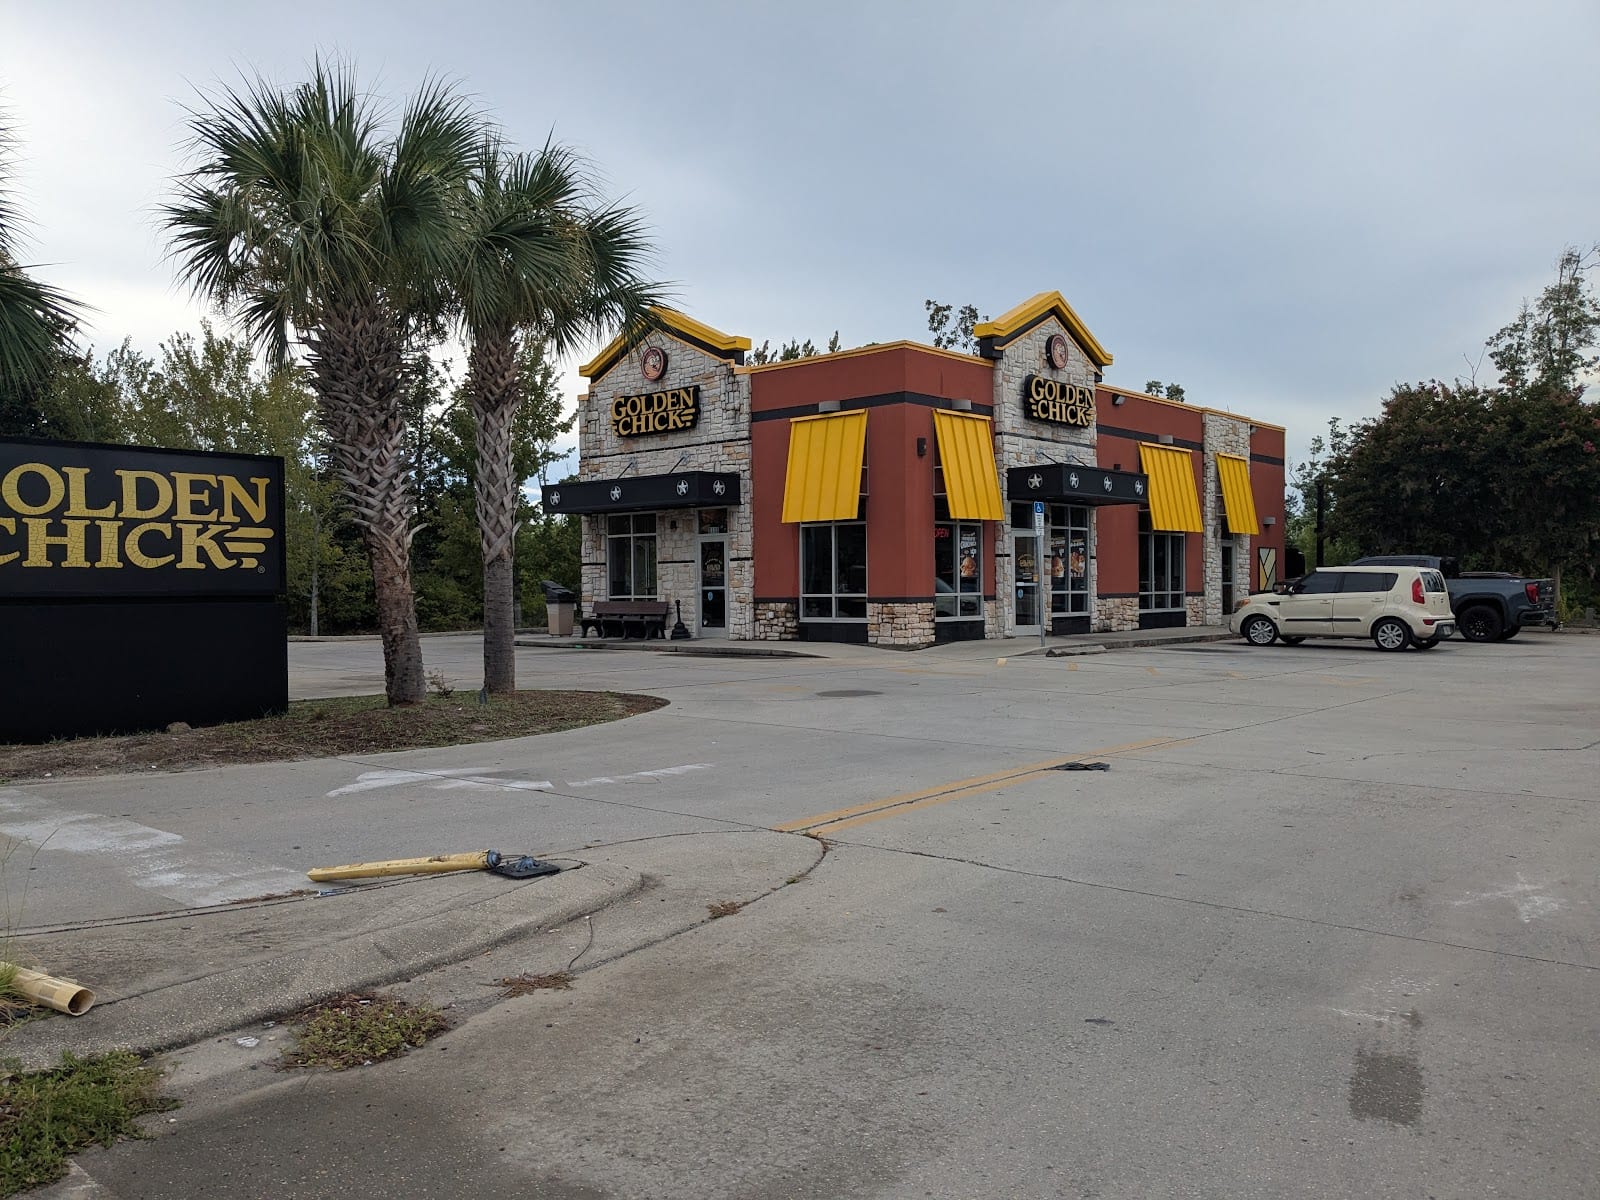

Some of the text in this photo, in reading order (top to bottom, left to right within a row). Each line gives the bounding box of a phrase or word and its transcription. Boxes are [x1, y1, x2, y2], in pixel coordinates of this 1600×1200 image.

[611, 387, 694, 421] GOLDEN
[1031, 377, 1095, 409] GOLDEN
[618, 409, 685, 436] CHICK
[1037, 400, 1089, 426] CHICK
[0, 462, 271, 524] OLDEN
